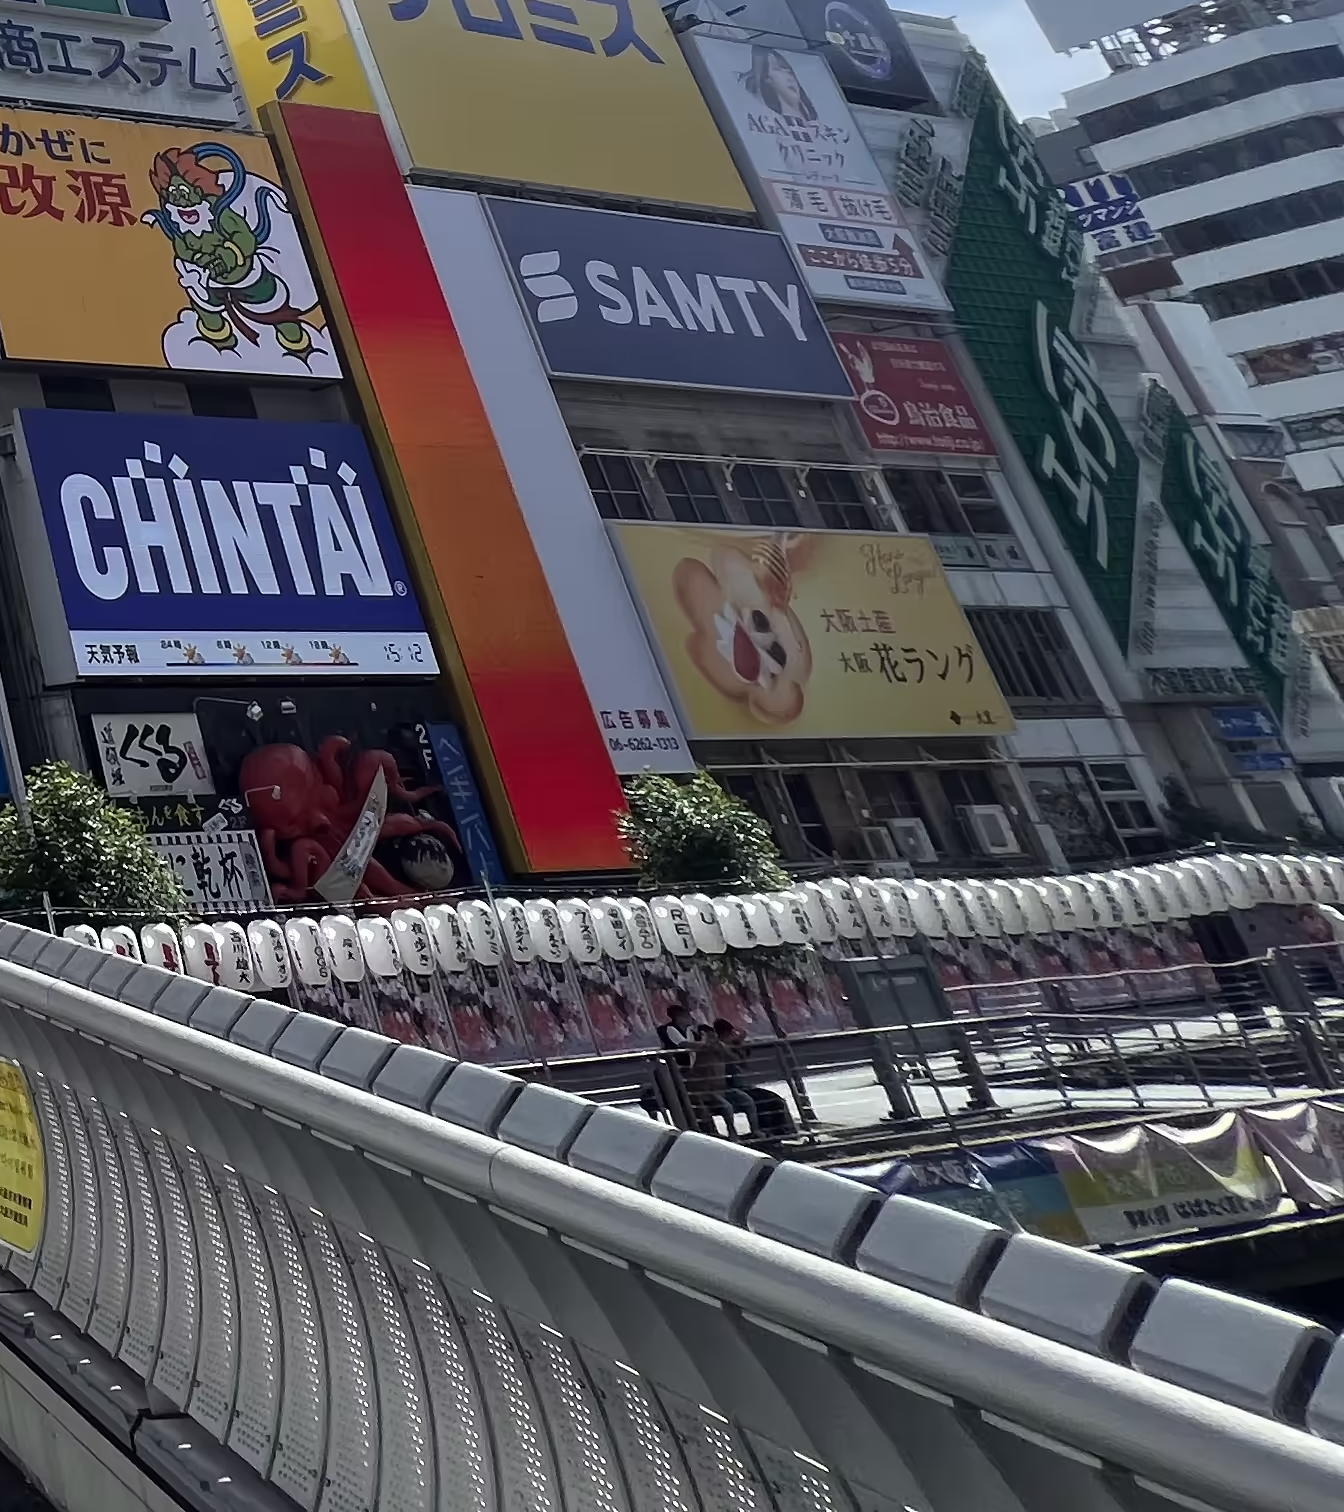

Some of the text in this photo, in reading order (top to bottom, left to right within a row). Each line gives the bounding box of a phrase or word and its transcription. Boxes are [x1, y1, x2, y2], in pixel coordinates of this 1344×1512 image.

[584, 259, 807, 342] SAMTY
[60, 440, 394, 601] CHINTAI
[85, 642, 141, 665] 天気予報
[599, 709, 671, 730] 広告募集
[119, 723, 188, 784] くくる
